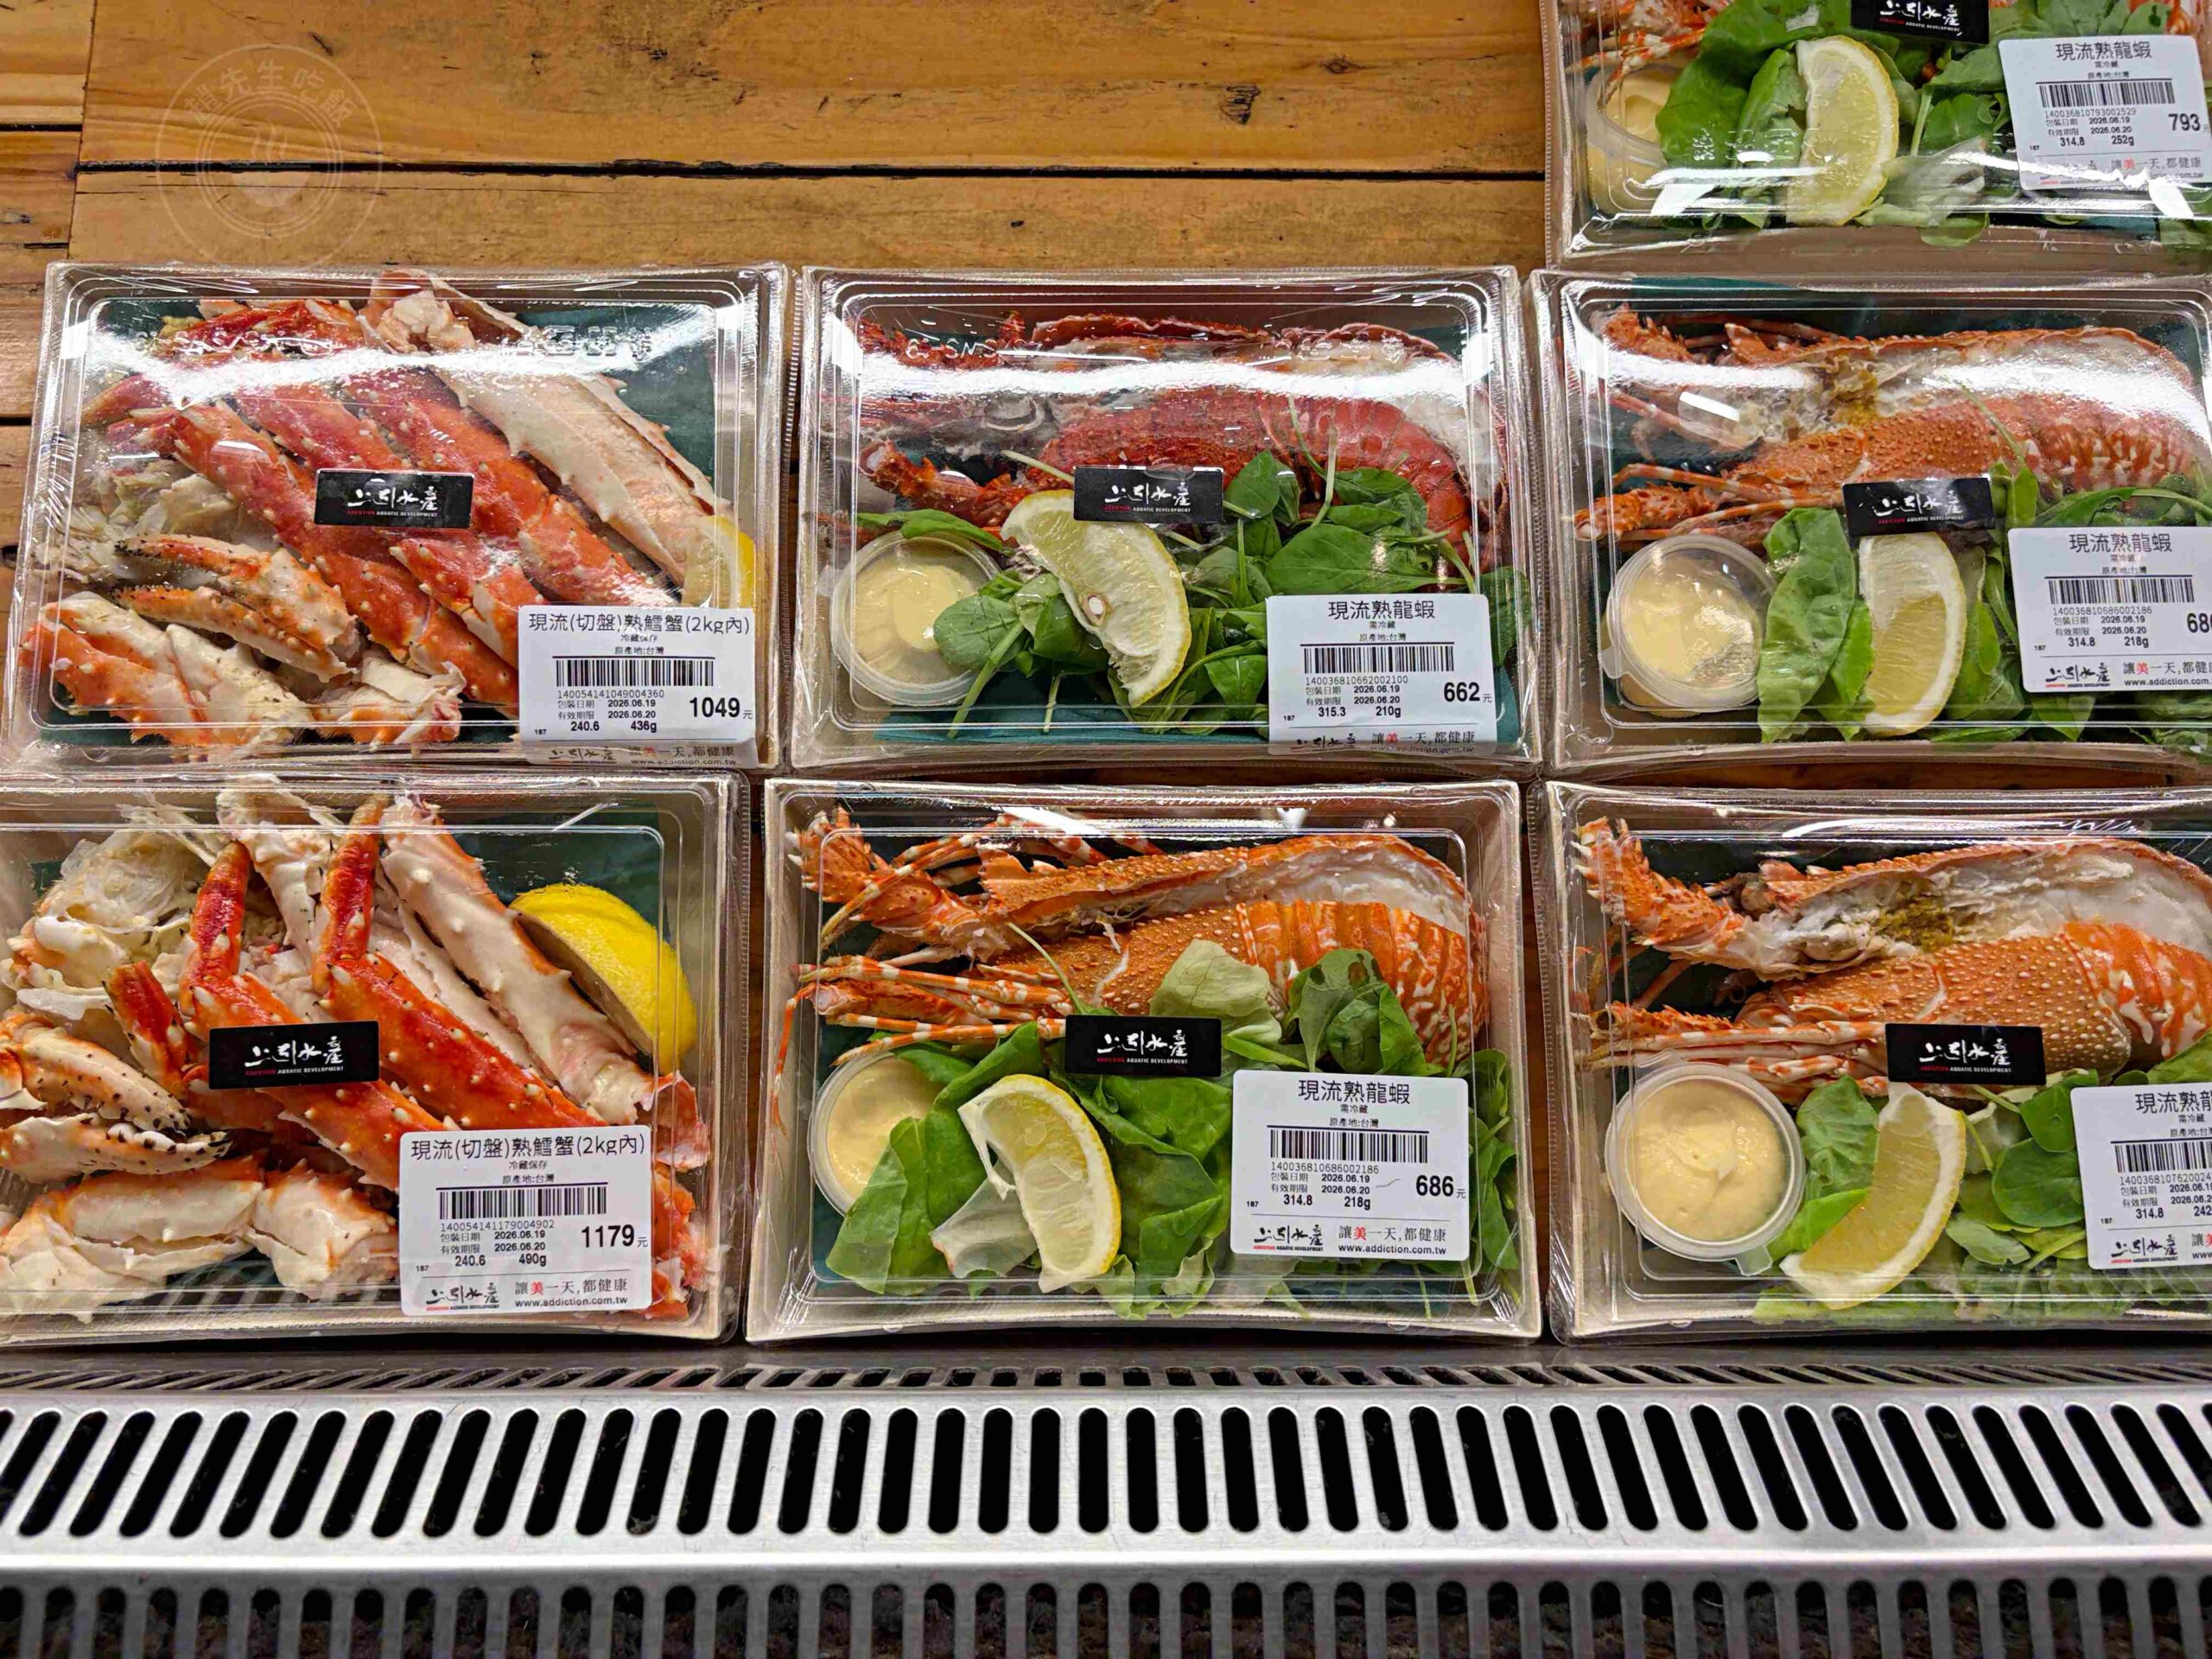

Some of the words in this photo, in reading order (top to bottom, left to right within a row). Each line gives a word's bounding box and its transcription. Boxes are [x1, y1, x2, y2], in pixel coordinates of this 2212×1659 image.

[2056, 41, 2152, 60] 現流熟龍蝦
[2046, 118, 2077, 127] 包裝日期
[2168, 113, 2201, 131] 793
[2060, 137, 2085, 146] 314.8
[2111, 136, 2134, 146] 252g
[2069, 532, 2172, 553] 現流熟龍蝦
[1328, 600, 1435, 620] 現流熟龍蝦
[2053, 617, 2089, 626] 包裝日期
[2187, 613, 2212, 633] 68
[2068, 637, 2095, 646] 314.8
[2124, 636, 2149, 648] 218g
[2123, 661, 2212, 675] 讓美一天,都健
[1306, 676, 1408, 686] 140036810662002100
[557, 690, 664, 698] 140054141049004360
[1306, 686, 1341, 696] 包裝日期
[1354, 685, 1400, 694] 2026.06.19
[1444, 682, 1480, 702] 662
[1483, 694, 1492, 703] 元
[557, 700, 594, 709] 包裝日期
[607, 699, 656, 708] 2026.06.19
[1354, 696, 1401, 704] 2026.06.20
[690, 697, 741, 717] 1049
[742, 710, 753, 720] 元
[1319, 707, 1346, 717] 315.3
[1376, 706, 1402, 717] 210g
[607, 710, 656, 719] 2026.06.20
[571, 721, 600, 731] 240.6
[631, 721, 657, 733] 436g
[1298, 1080, 1410, 1104] 現流熟龍蝦
[1329, 1117, 1379, 1128] 原產地:台灣
[508, 1160, 548, 1170] 冷藏保存
[1271, 1161, 1379, 1174] 140036810686002186
[502, 1173, 554, 1184] 原產地:台灣
[1270, 1172, 1308, 1182] 包裝日期
[1321, 1173, 1370, 1183] 2026.06.19
[2120, 1173, 2212, 1185] 1400368107620024
[1321, 1185, 1370, 1194] 2026.06.20
[1415, 1175, 1454, 1198] 686
[1456, 1188, 1466, 1199] 元
[2120, 1185, 2158, 1196] 包裝日期
[1283, 1194, 1313, 1205] 314.8
[1344, 1197, 1370, 1210] 218g
[2171, 1194, 2212, 1205] 2026.06.2
[2136, 1208, 2164, 1219] 314.8
[441, 1219, 555, 1230] 140054141179004902
[441, 1231, 480, 1243] 包裝日期
[494, 1230, 545, 1240] 2026.06.19
[582, 1224, 635, 1248] 1179
[637, 1236, 648, 1248] 元
[1338, 1225, 1446, 1243] 讓美一天,都健康
[494, 1243, 545, 1252] 2026.06.20
[1338, 1244, 1446, 1255] www.addiction.com.tw
[454, 1255, 486, 1266] 240.6
[518, 1253, 547, 1267] 490g
[515, 1278, 627, 1295] 讓美一天,都健康
[515, 1296, 628, 1307] www.addiction.com.tw
